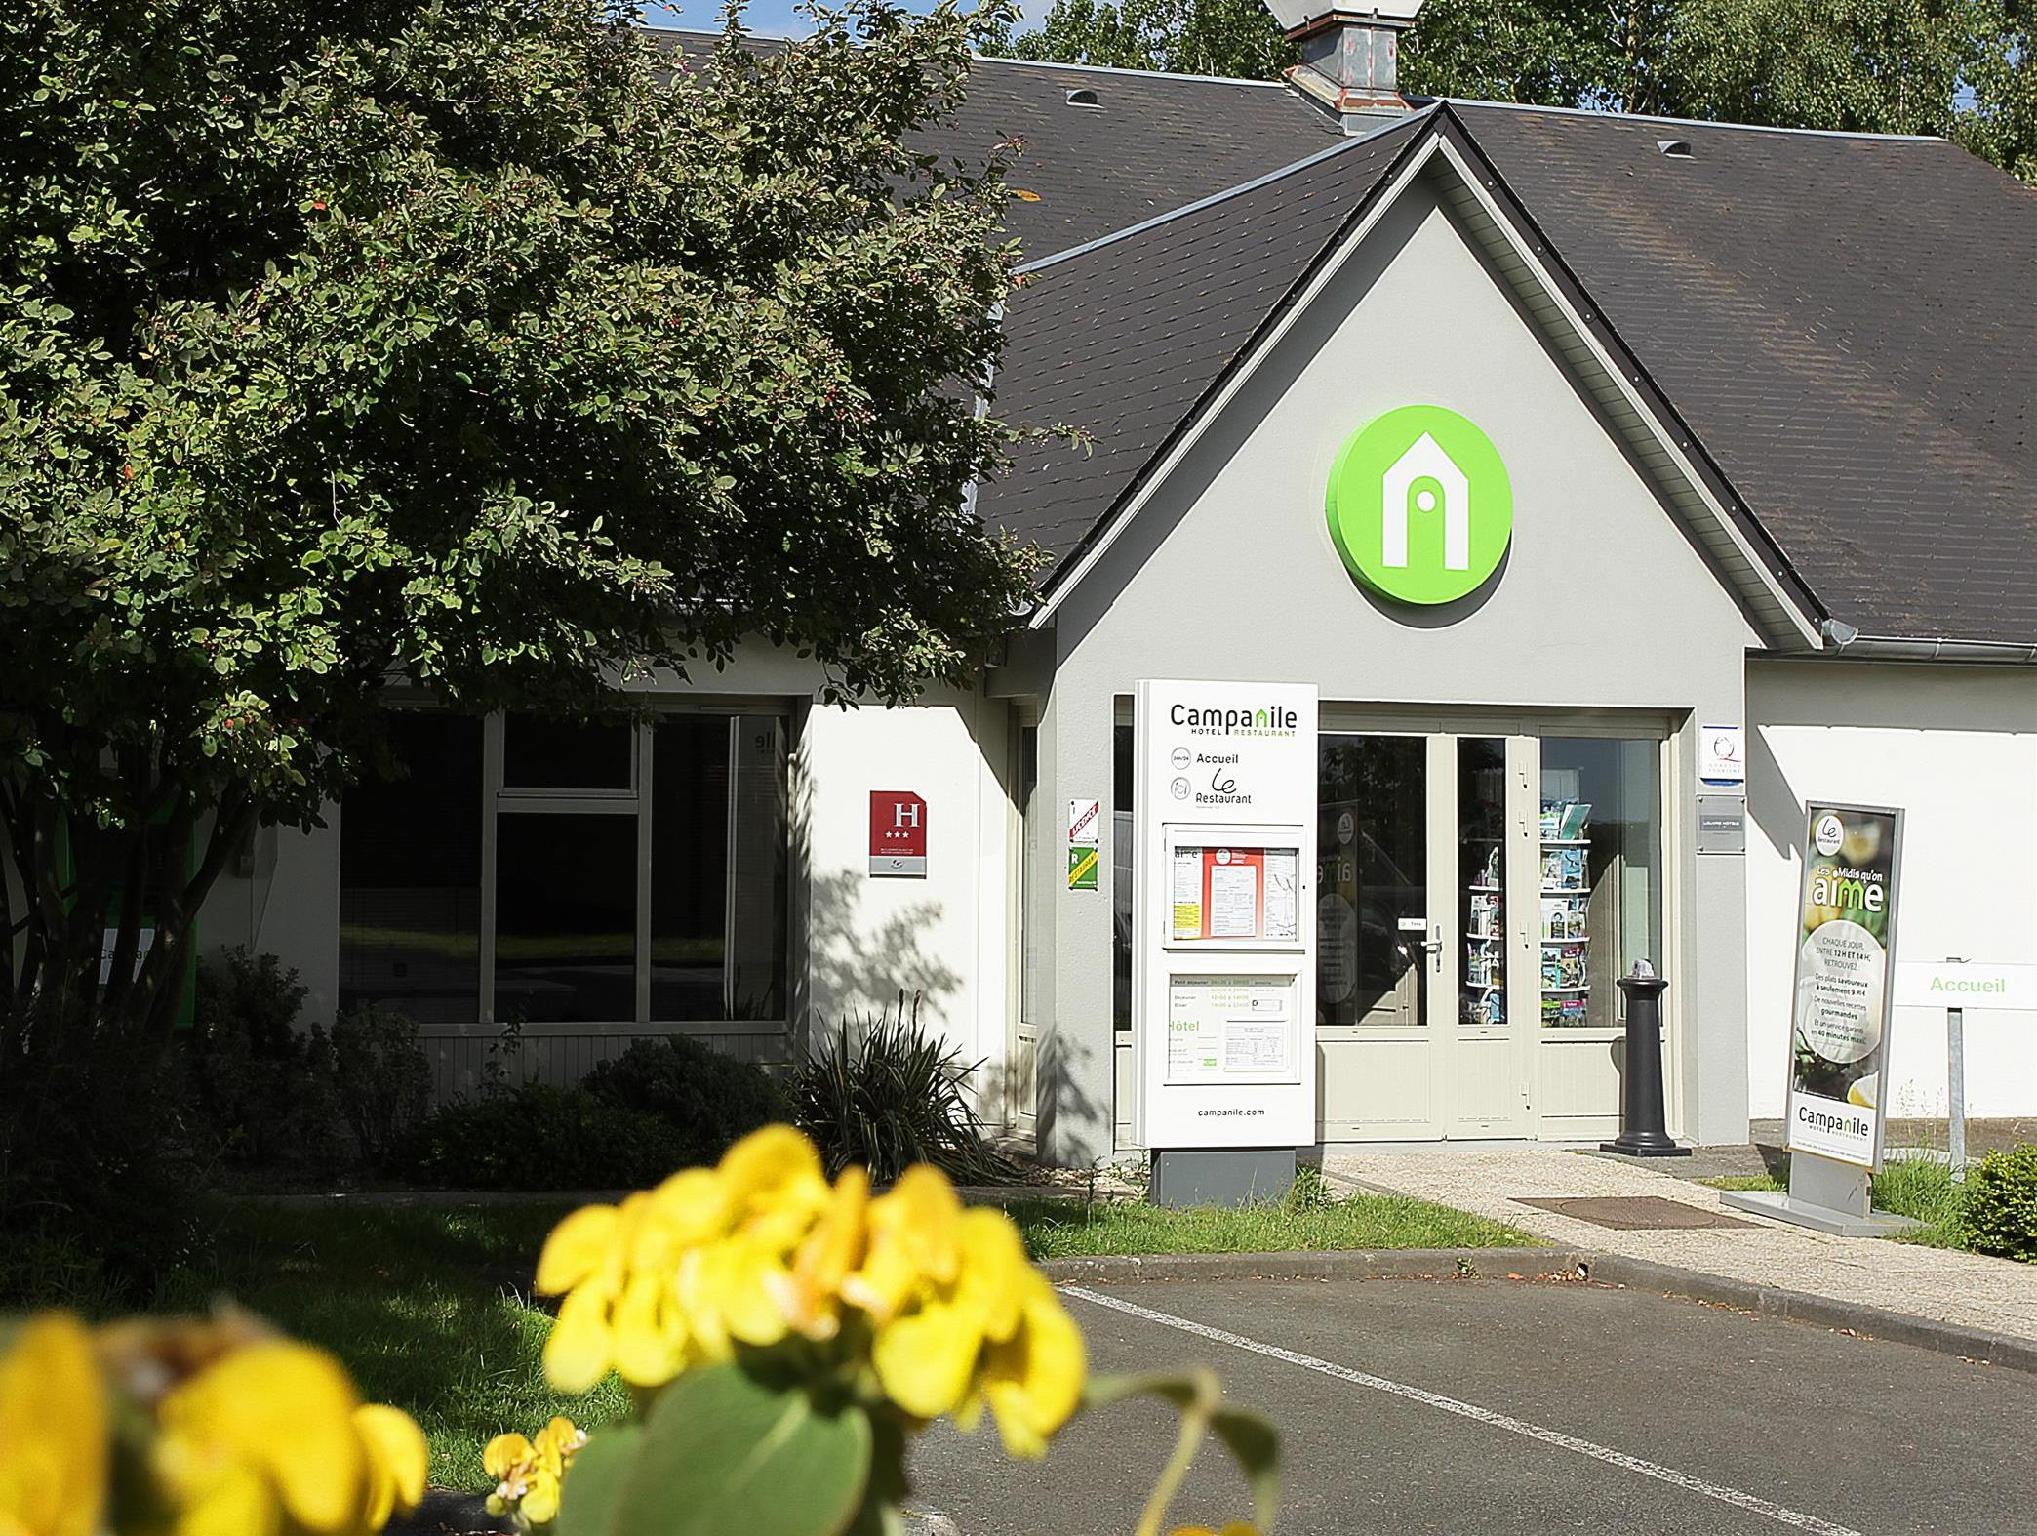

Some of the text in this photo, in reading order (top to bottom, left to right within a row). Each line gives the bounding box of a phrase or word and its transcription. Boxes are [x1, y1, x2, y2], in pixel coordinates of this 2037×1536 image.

[1171, 704, 1298, 735] Campanile
[1191, 728, 1296, 737] HOTEL RESTAURANT
[1196, 753, 1239, 764] Accueil
[1211, 767, 1237, 793] Le
[1195, 792, 1252, 805] Restaurant
[894, 803, 920, 827] H
[1822, 818, 1837, 838] Le
[1071, 853, 1079, 864] R
[1861, 869, 1883, 883] qu'on
[1813, 878, 1884, 912] aime
[1822, 937, 1848, 948] CHAQUE
[1930, 977, 2006, 992] Accueil
[1821, 1008, 1858, 1020] gourmandes
[1198, 1108, 1265, 1117] campanile.com
[1800, 1107, 1868, 1136] Campanile
